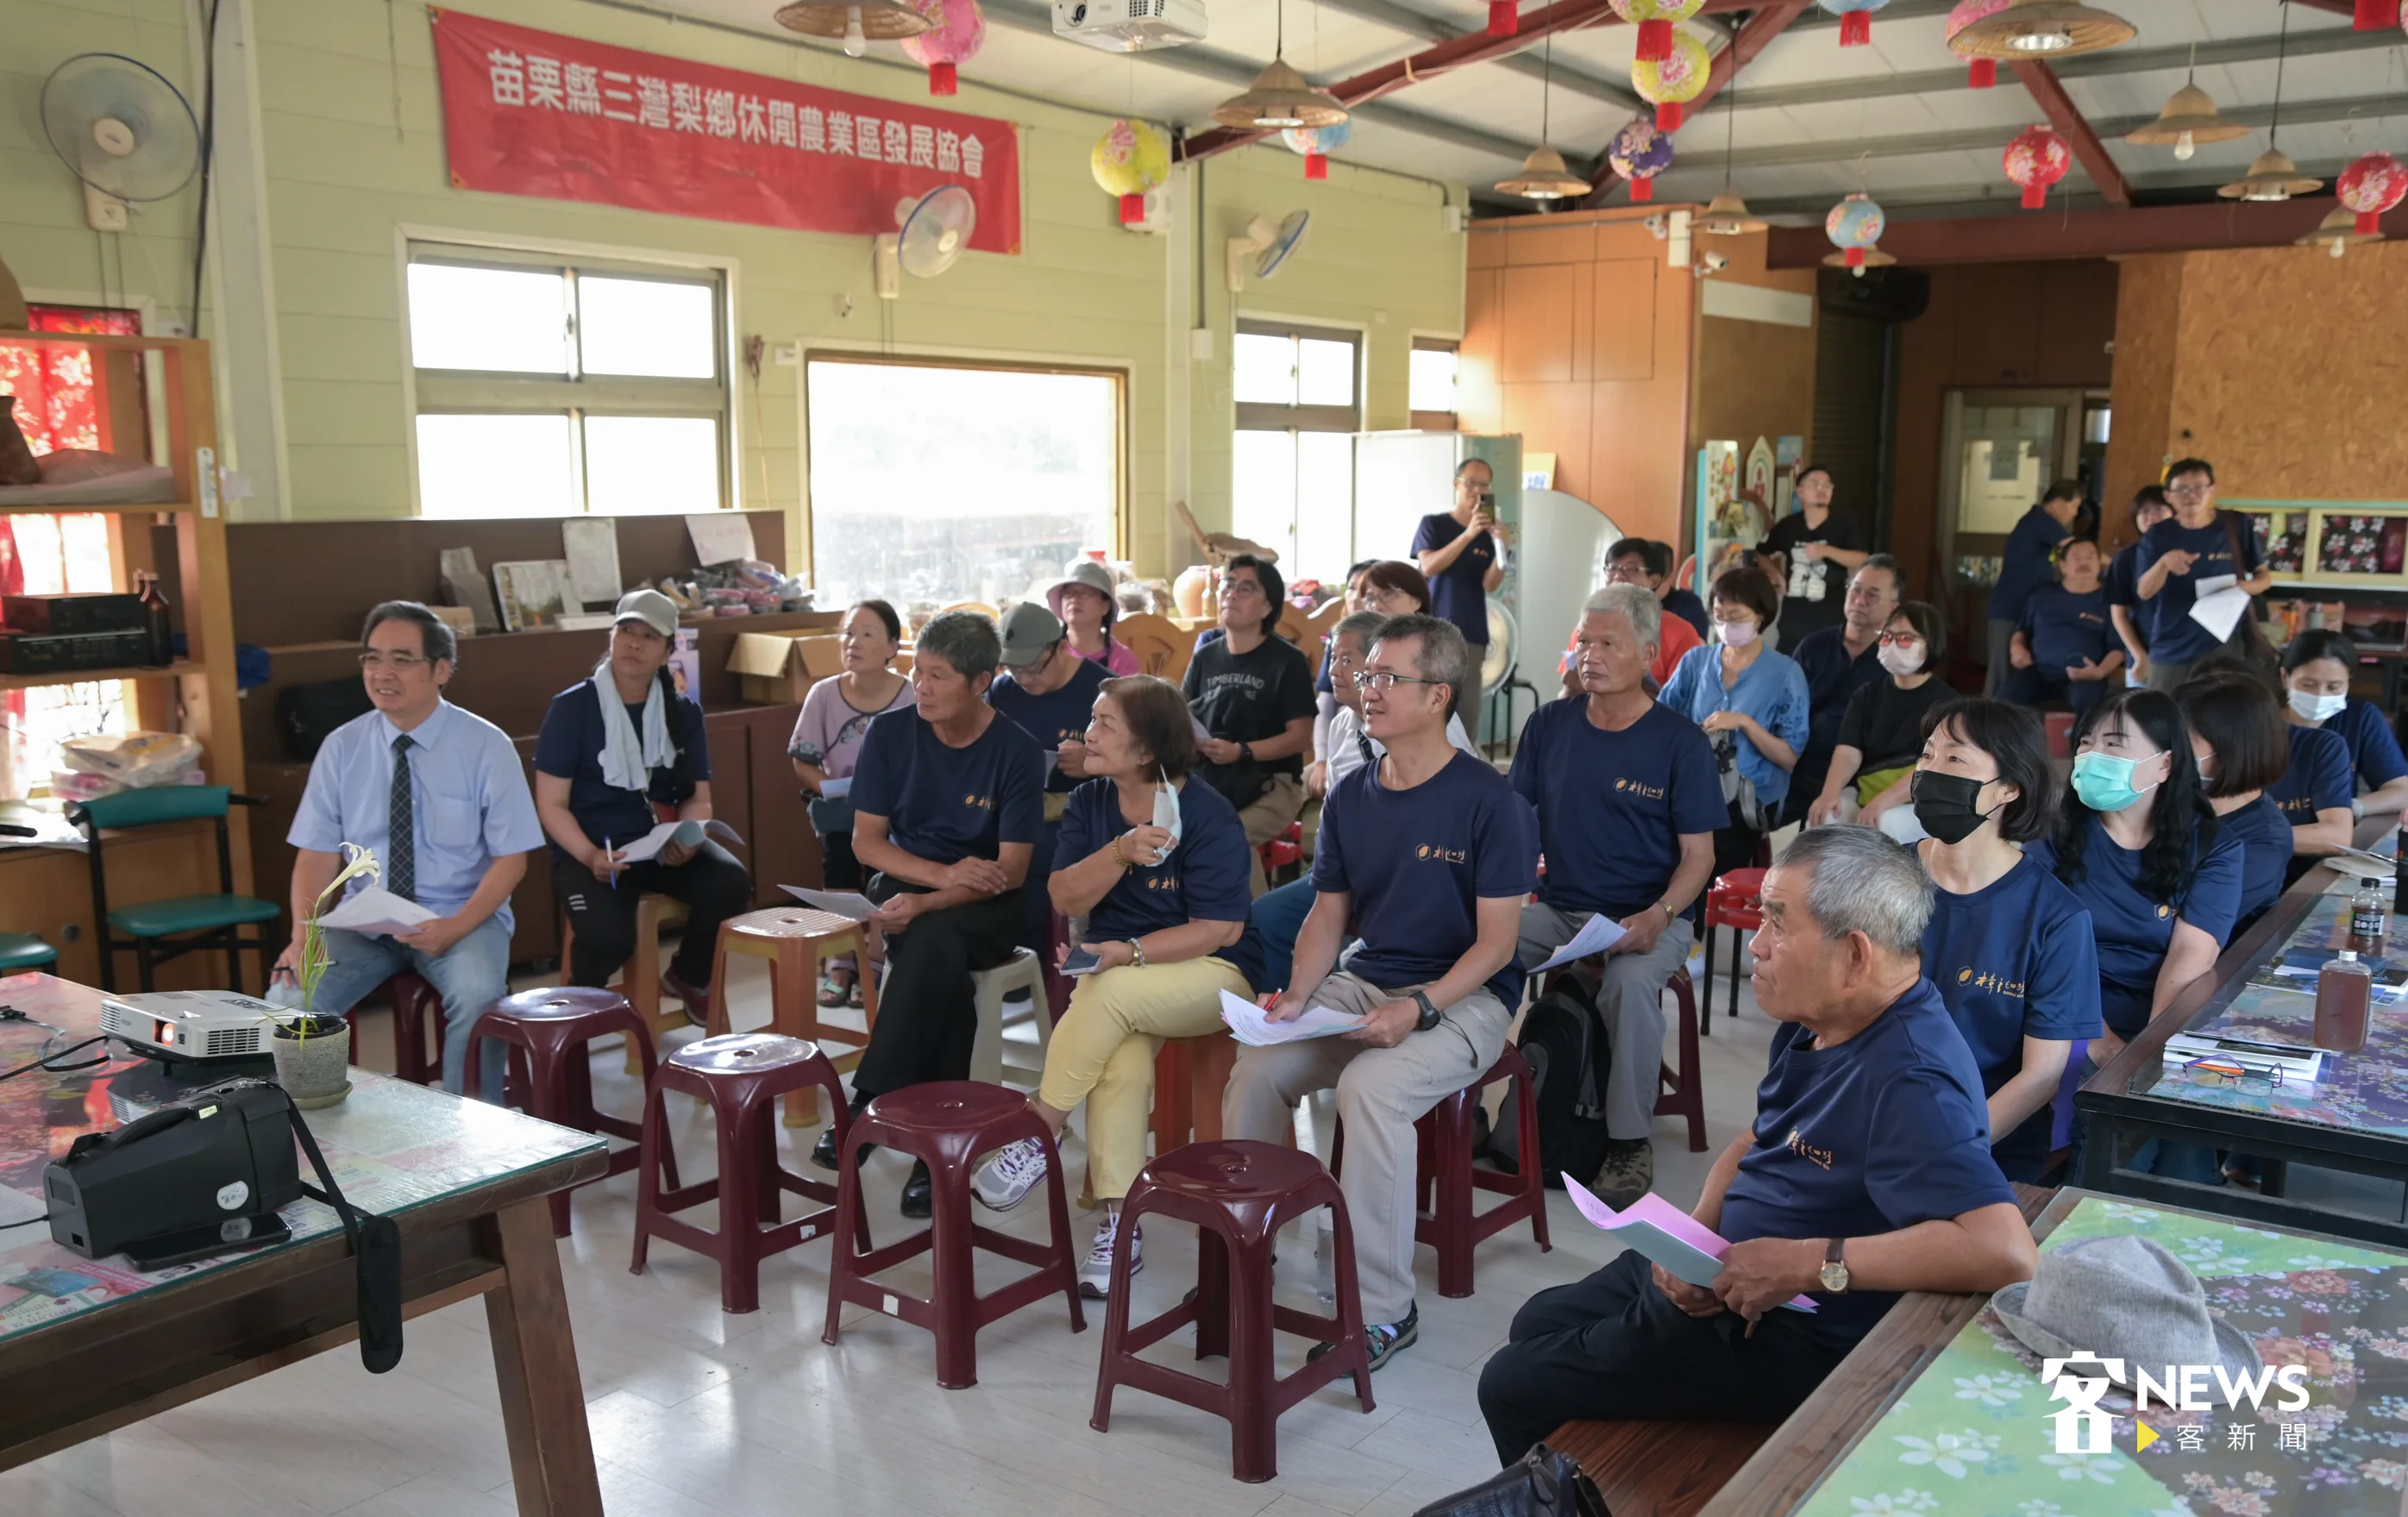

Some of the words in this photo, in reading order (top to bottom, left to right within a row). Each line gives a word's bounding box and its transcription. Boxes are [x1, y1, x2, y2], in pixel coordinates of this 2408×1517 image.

[486, 47, 984, 179] 苗栗縣三灣梨鄉休閒農業區發展協會
[1206, 673, 1264, 689] TIMBERLAND
